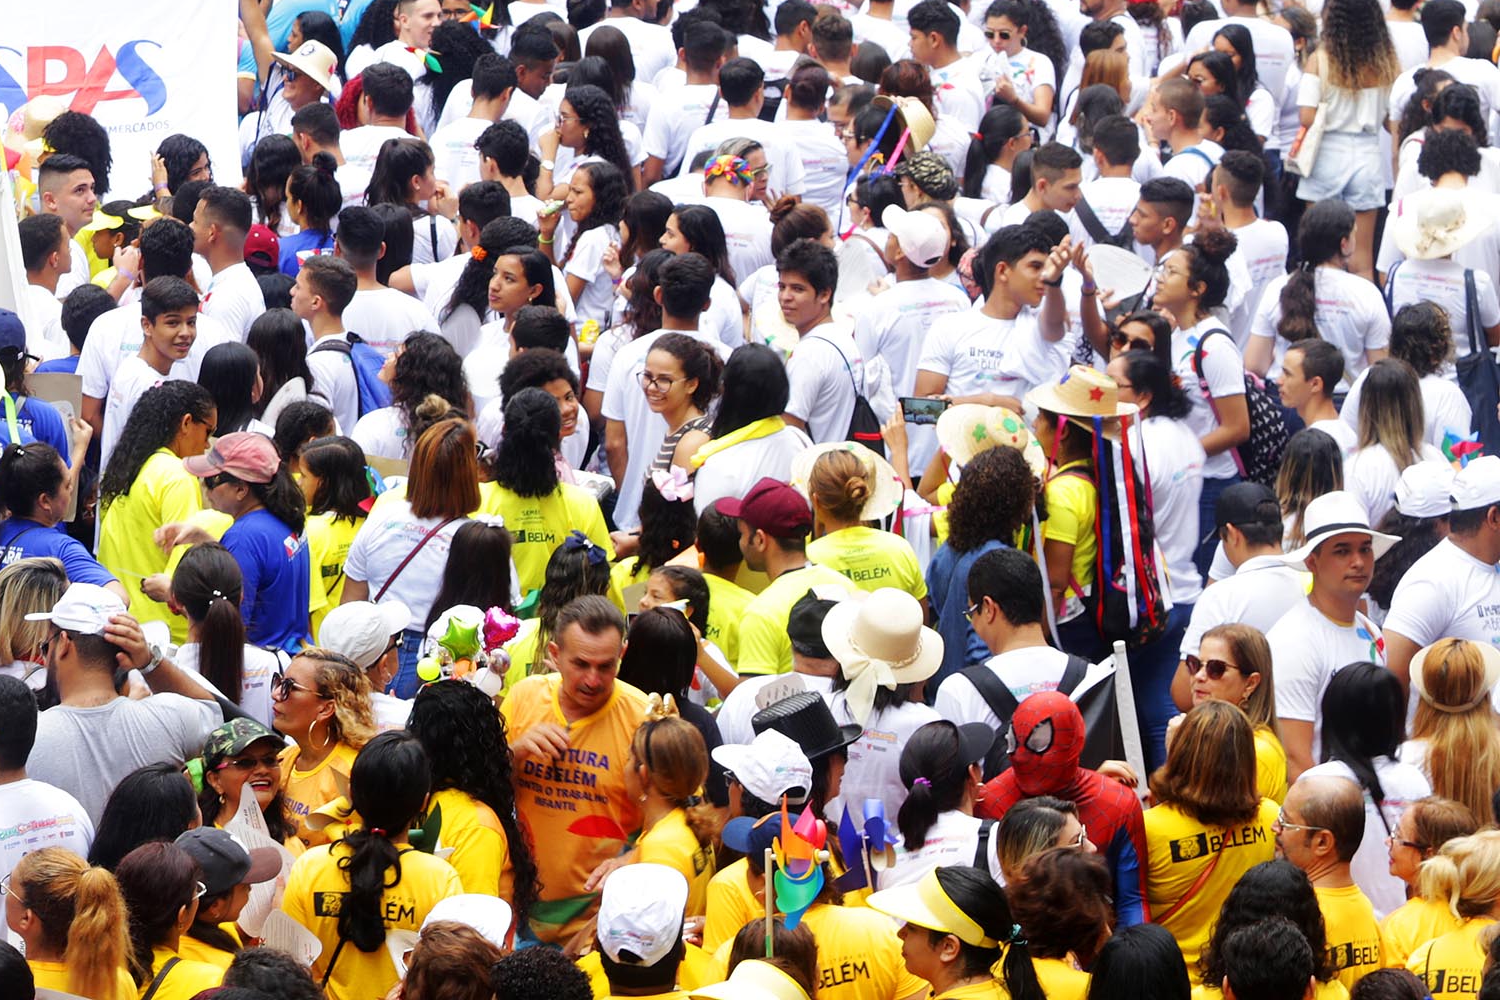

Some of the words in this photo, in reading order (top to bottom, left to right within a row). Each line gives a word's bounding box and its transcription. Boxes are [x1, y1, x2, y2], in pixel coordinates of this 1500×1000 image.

[853, 567, 892, 582] BELÉM
[1209, 826, 1267, 853] BELÉM
[1446, 975, 1479, 994] BEL
